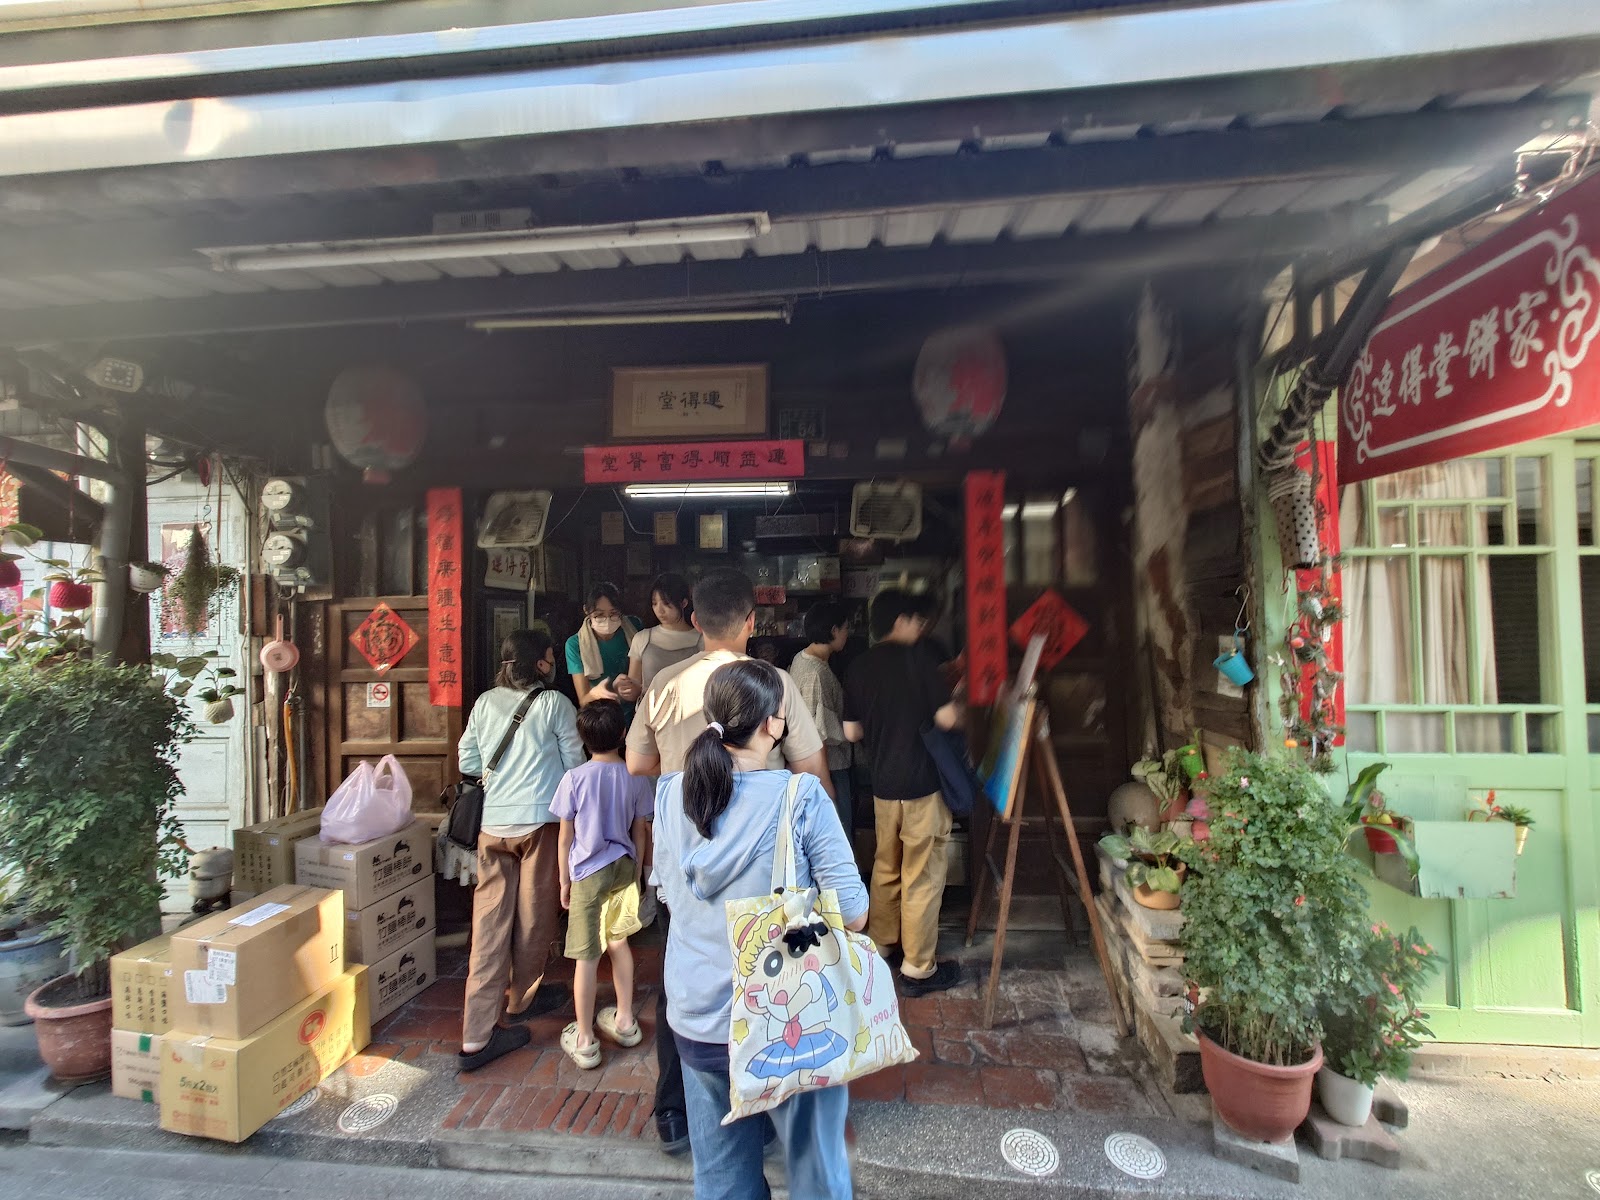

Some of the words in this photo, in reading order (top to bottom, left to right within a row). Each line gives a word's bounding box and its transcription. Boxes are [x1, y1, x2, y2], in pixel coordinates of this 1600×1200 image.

[1371, 290, 1548, 417] 連得堂餅家
[658, 390, 724, 410] 連得堂
